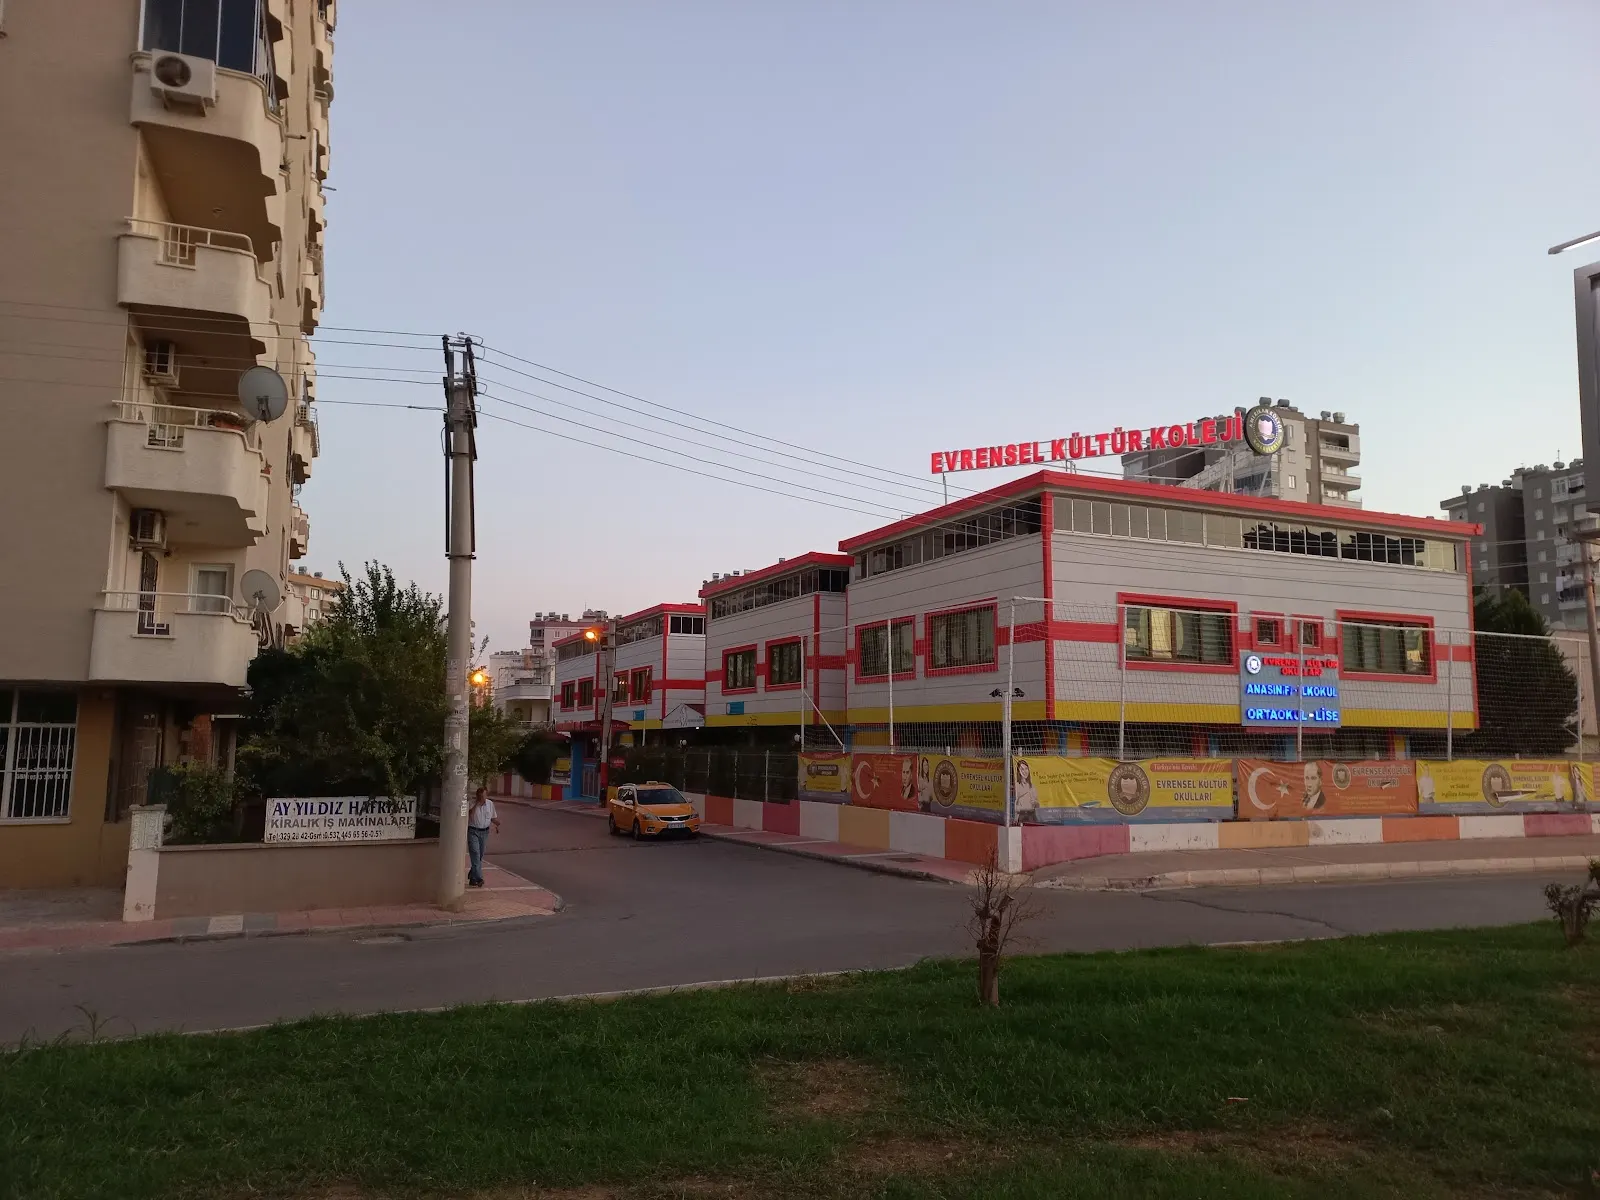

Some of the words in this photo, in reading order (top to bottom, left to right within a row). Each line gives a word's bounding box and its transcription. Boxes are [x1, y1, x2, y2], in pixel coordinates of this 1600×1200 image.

[931, 441, 1045, 475] EVRENSEL
[1051, 426, 1144, 460] KÜLTÜR
[1151, 411, 1243, 449] KOLEJİ
[1315, 707, 1339, 722] LİSE
[1156, 779, 1197, 789] EVRENSEL
[1198, 778, 1229, 789] KÜLTÜR
[1174, 791, 1212, 801] OKULLARI
[272, 801, 292, 816] AY
[295, 801, 344, 815] YILDIZ
[271, 817, 320, 829] KİRALIK
[323, 816, 335, 829] İŞ
